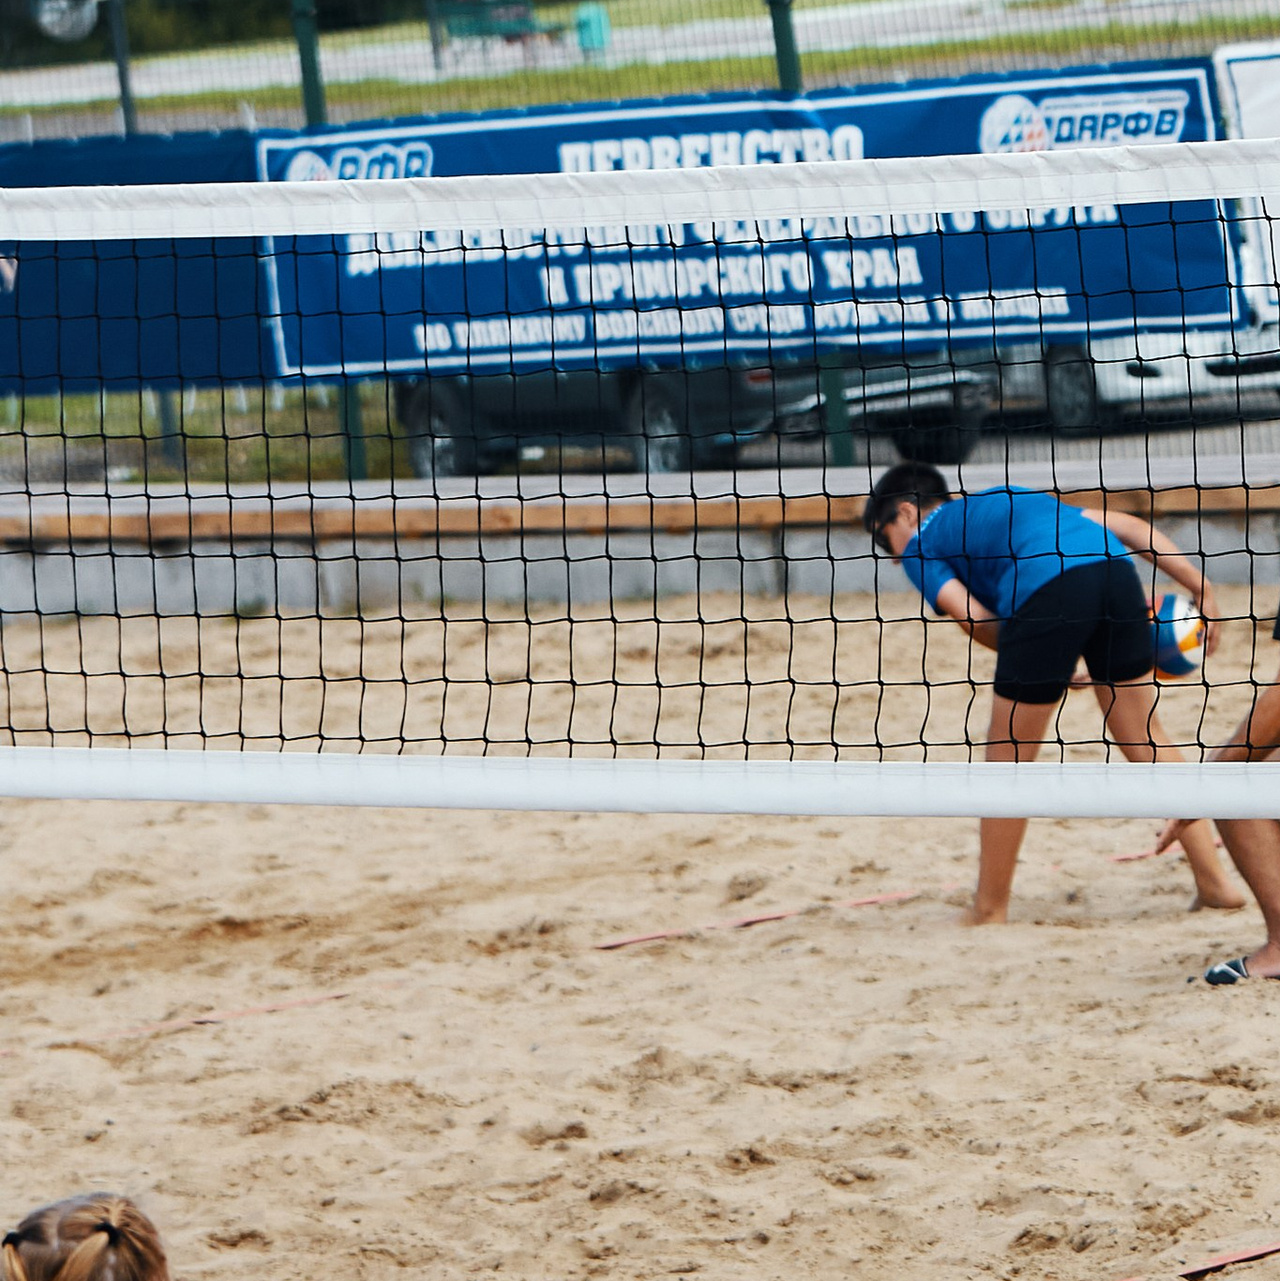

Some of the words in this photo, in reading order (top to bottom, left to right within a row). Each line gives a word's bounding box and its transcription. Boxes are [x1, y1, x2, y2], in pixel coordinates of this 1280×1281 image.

[1054, 108, 1178, 144] ДАРФВ
[558, 124, 864, 173] ПЕРВЕНСТВО
[540, 265, 569, 305] И
[573, 250, 814, 304] ПРИМОРСКОГО
[821, 245, 924, 290] КРАЯ
[413, 323, 452, 352] ПО
